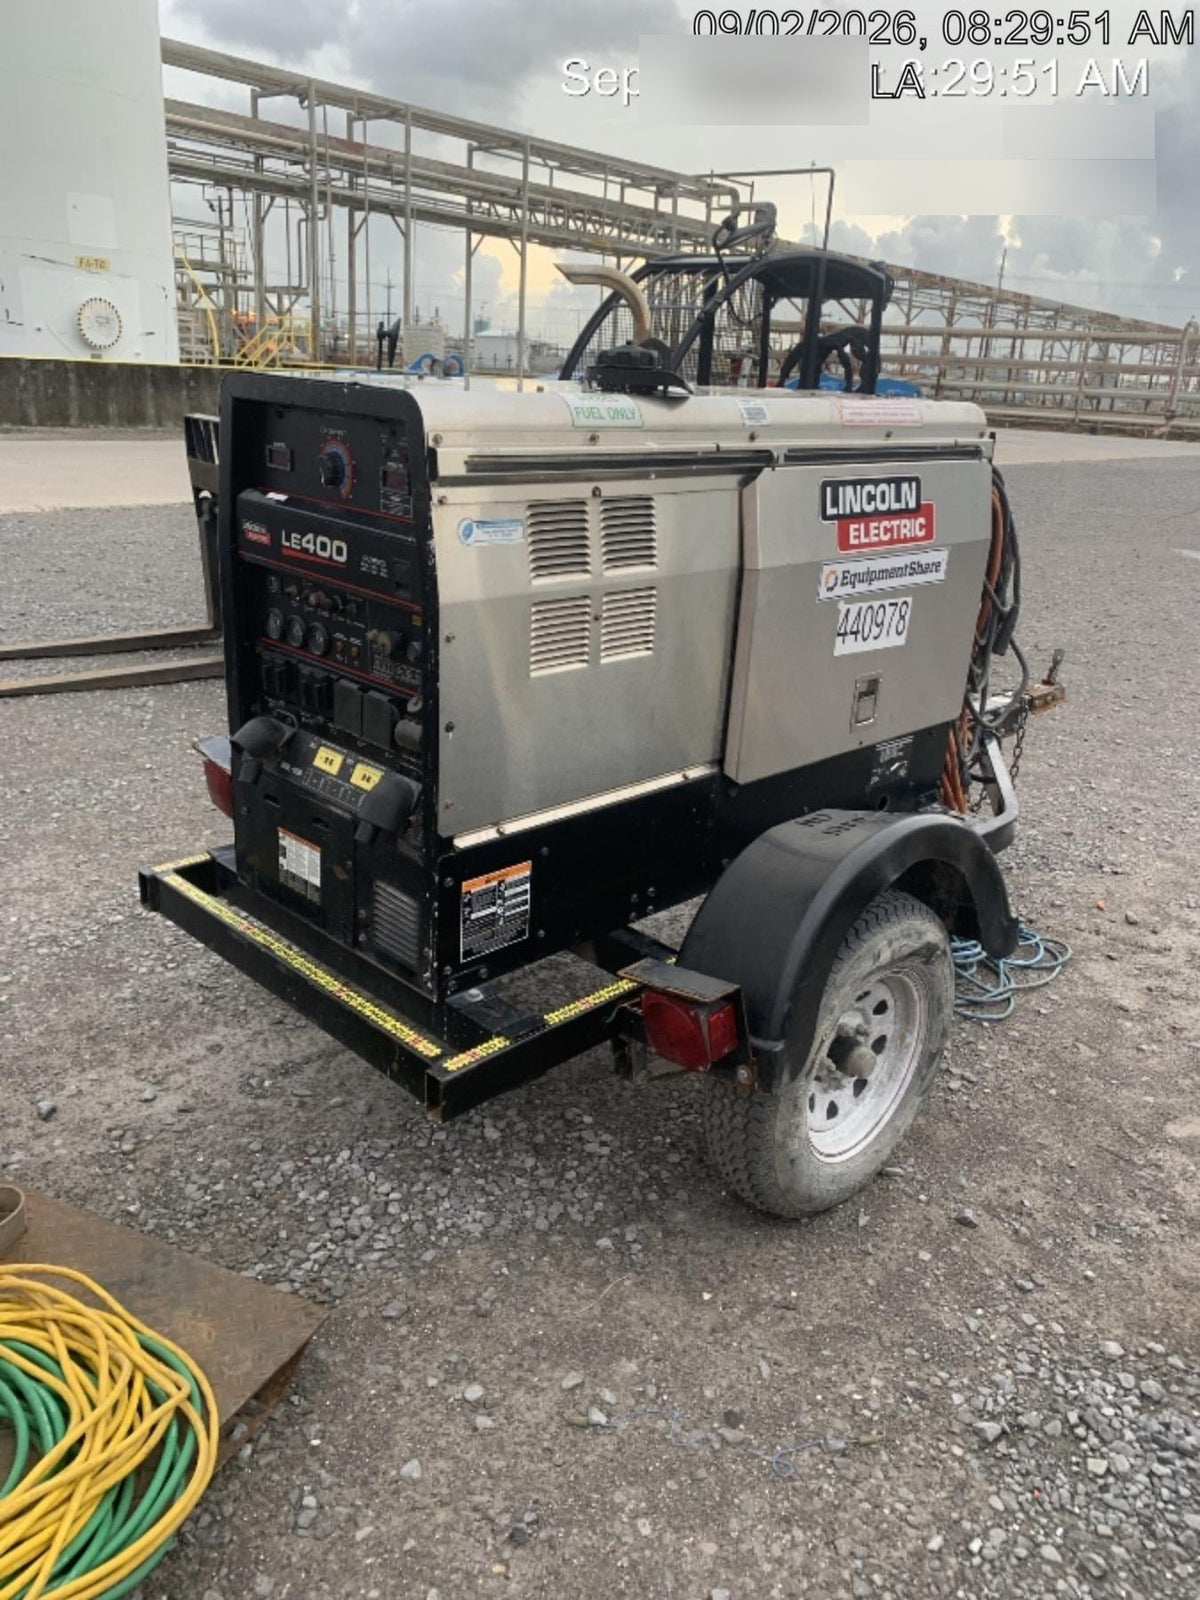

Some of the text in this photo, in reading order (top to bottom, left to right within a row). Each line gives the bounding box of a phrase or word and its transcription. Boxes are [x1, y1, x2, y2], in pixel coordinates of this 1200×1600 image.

[574, 406, 636, 420] FUEL ONLY
[825, 481, 917, 517] LINCOLN
[281, 529, 348, 563] LE400
[849, 517, 926, 545] ELECTRIC
[840, 560, 942, 589] EquipmentShare
[837, 600, 910, 645] 440978
